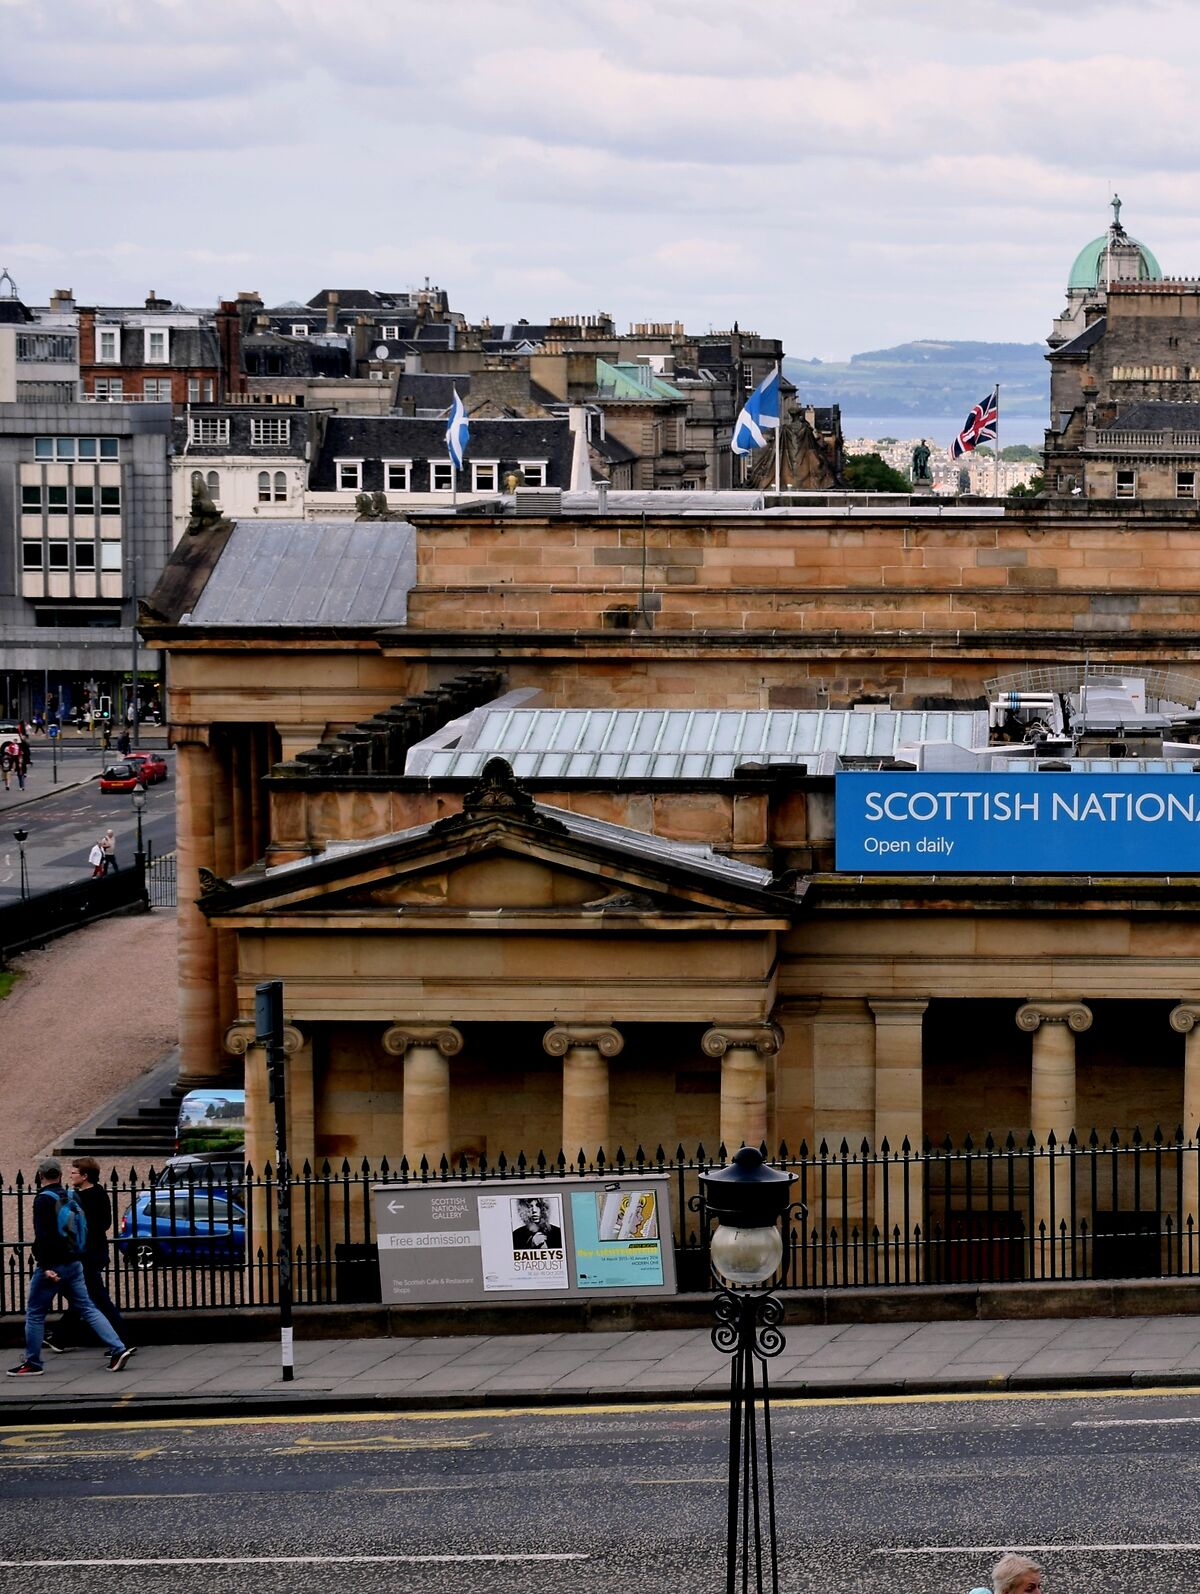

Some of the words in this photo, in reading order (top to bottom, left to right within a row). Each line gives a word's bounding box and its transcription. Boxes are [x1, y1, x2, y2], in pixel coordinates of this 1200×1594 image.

[864, 791, 1040, 822] SCOTTISH
[864, 836, 911, 856] Open
[915, 836, 955, 856] daily
[431, 1198, 466, 1206] SCOTTISH
[431, 1204, 470, 1213] NATIONAL
[432, 1212, 463, 1220] GALLERY
[390, 1235, 413, 1247] Free
[416, 1233, 471, 1246] admission
[513, 1250, 563, 1261] BAILEYS
[513, 1260, 563, 1271] STARDUST
